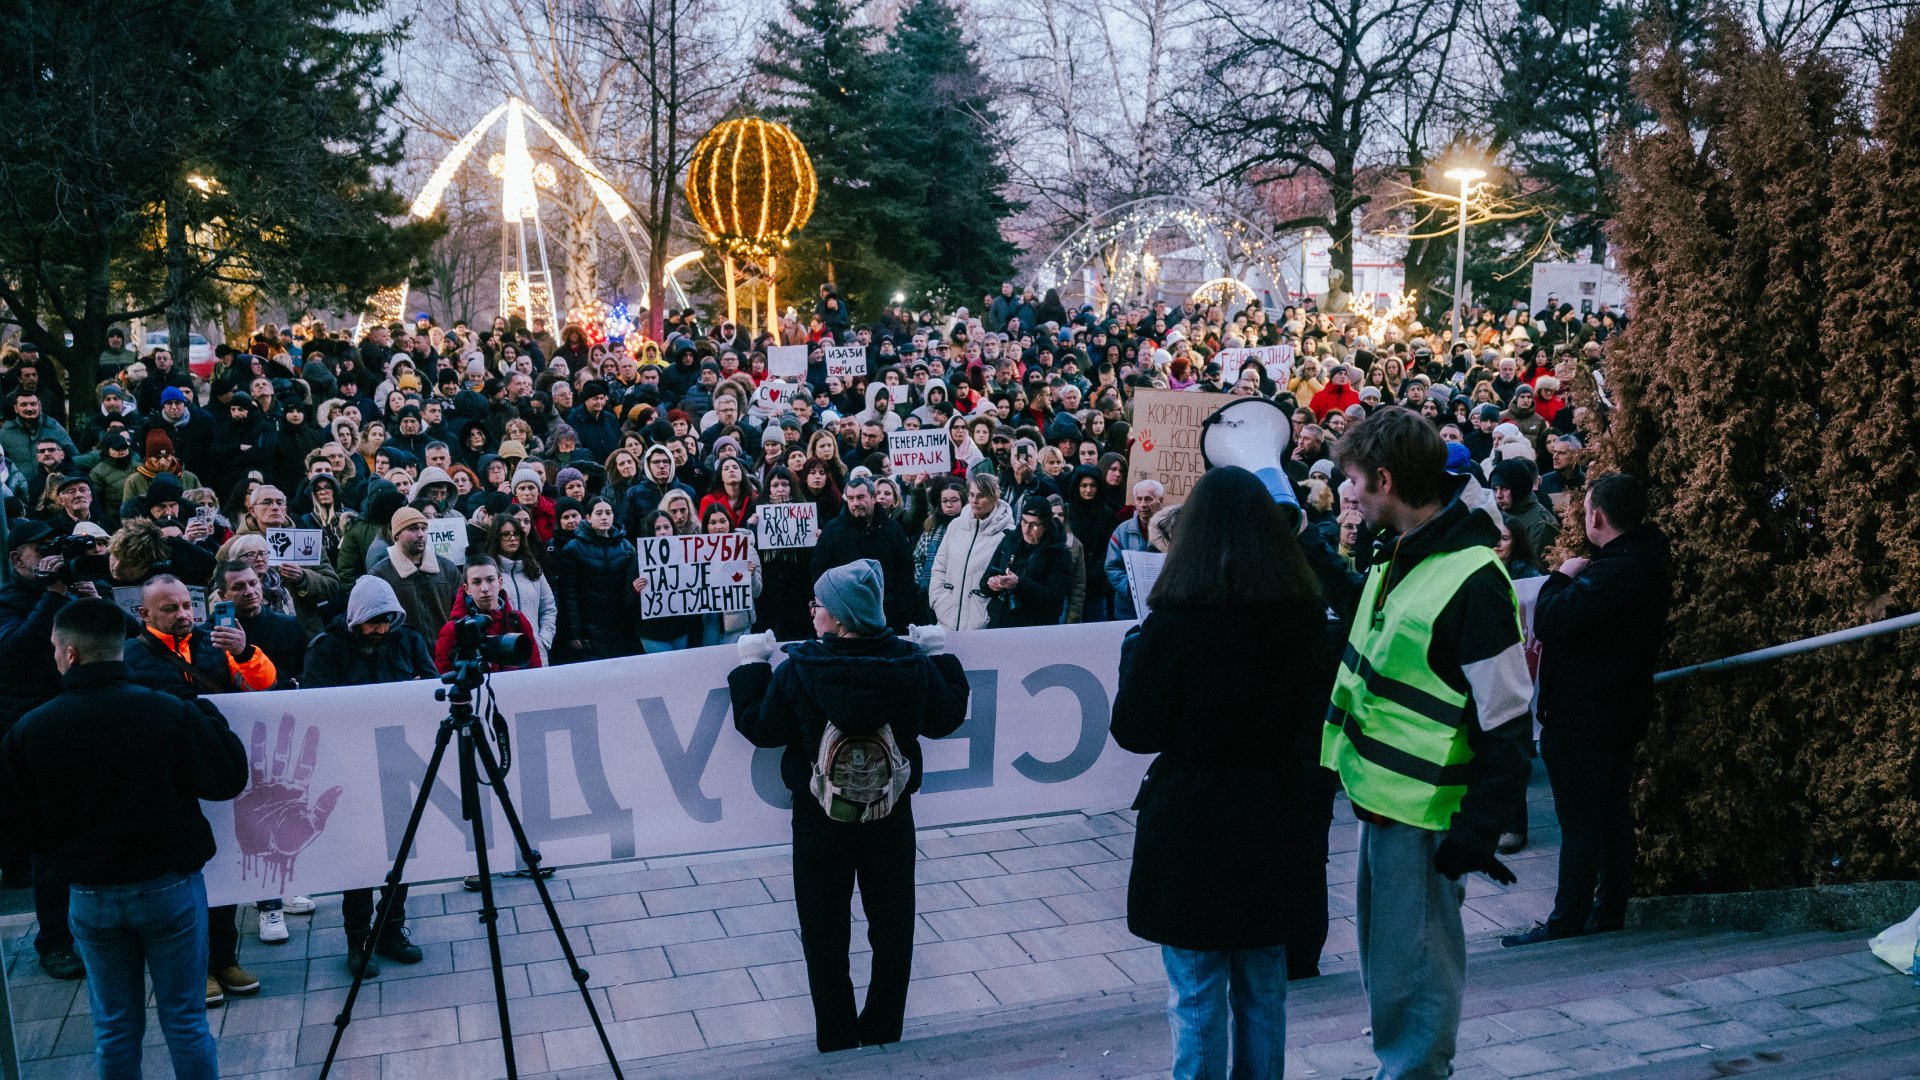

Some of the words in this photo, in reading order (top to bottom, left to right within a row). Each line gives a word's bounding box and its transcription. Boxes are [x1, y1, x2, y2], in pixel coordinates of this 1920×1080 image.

[829, 365, 852, 375] БОРИ
[855, 364, 865, 374] СЕ
[889, 433, 947, 449] ГЕНЕРАЛНИ
[893, 450, 944, 467] ШТРАЈК
[763, 505, 814, 520] БЛОКАДА
[765, 518, 789, 535] АКО
[796, 517, 811, 533] НЕ
[770, 532, 807, 546] САДА?
[644, 538, 670, 566] КО
[679, 535, 748, 563] ТРУБИ
[643, 564, 679, 592] ТАЈ
[686, 562, 711, 588] ЈЕ
[643, 592, 663, 617] УЗ
[667, 584, 750, 614] СТУДЕНТЕ
